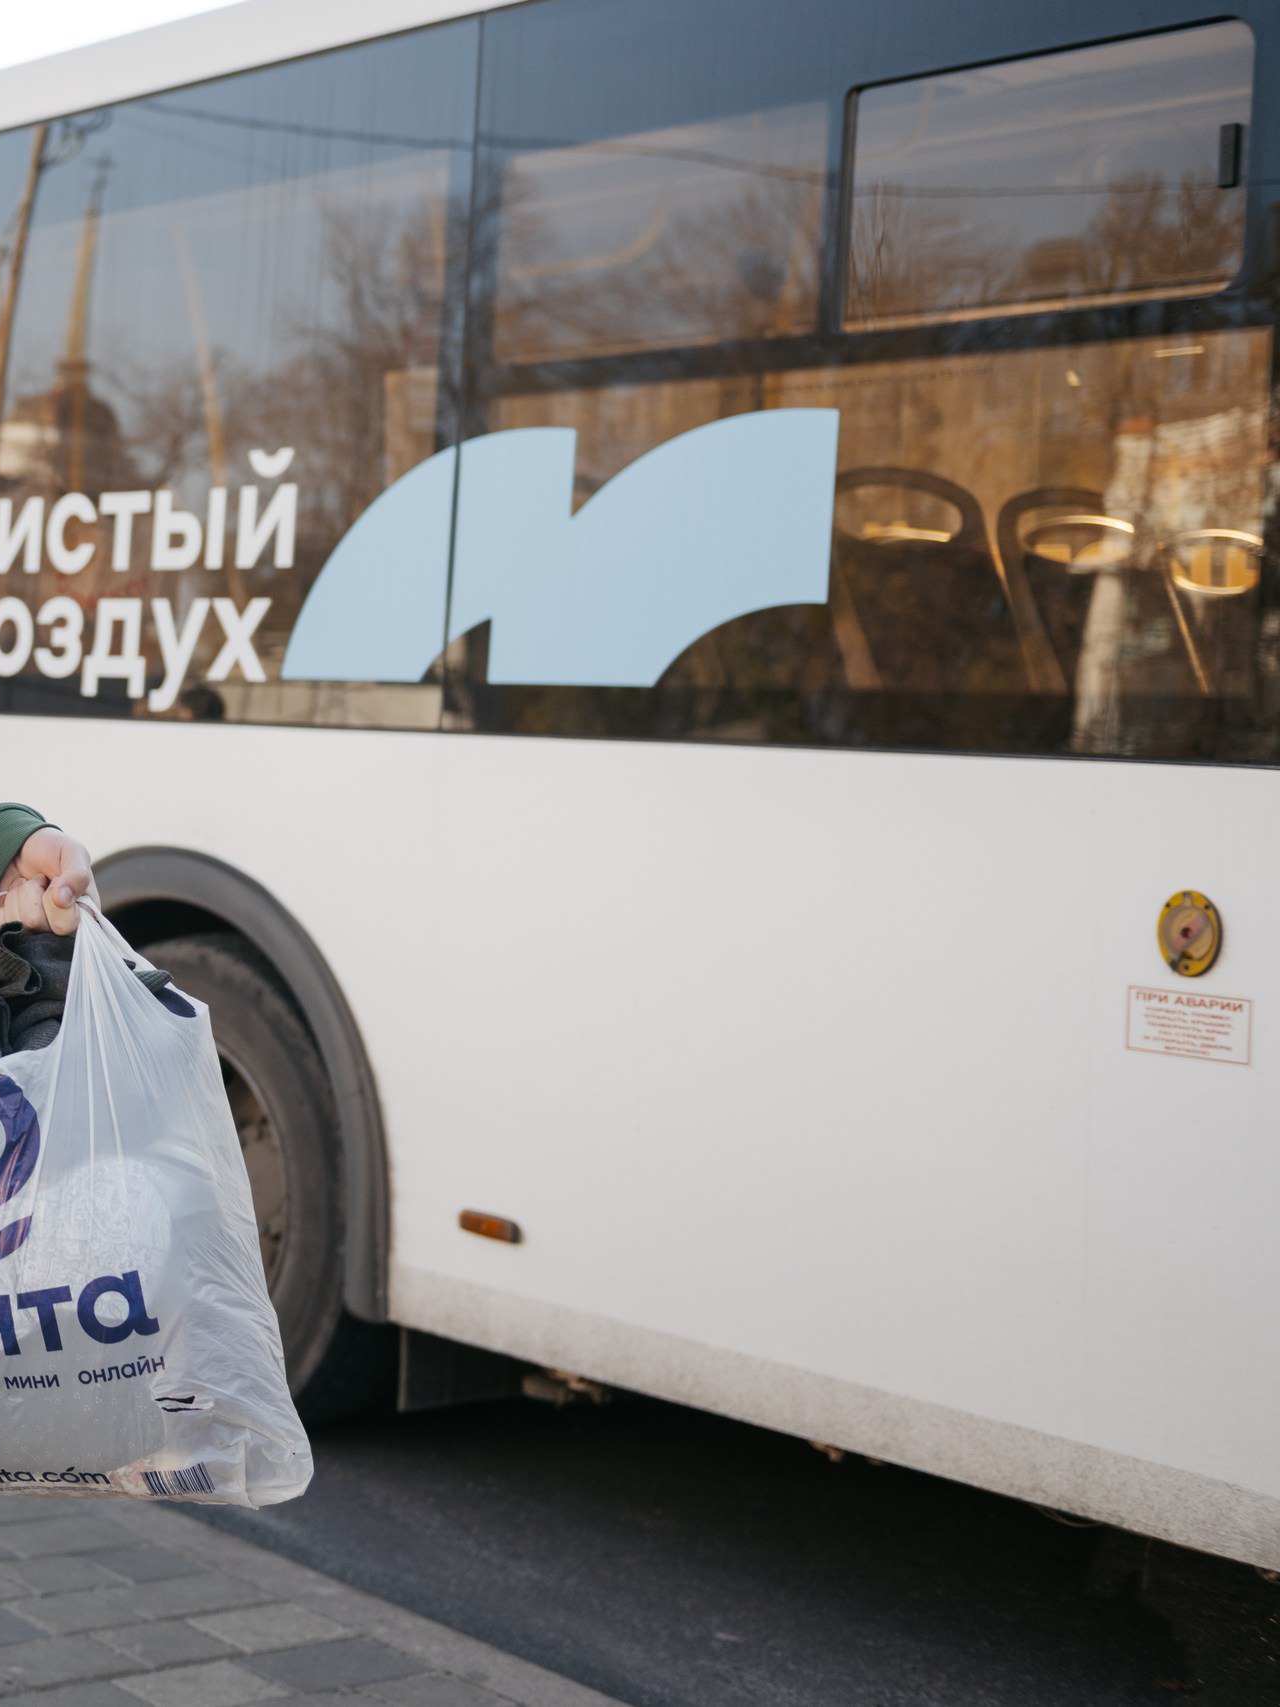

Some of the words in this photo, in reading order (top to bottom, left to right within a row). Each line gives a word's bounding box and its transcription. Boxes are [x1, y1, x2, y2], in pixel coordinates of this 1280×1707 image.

[1136, 991, 1168, 1003] ПРИ
[1175, 996, 1244, 1012] АВАРИИ
[4, 1374, 60, 1390] мини
[78, 1355, 166, 1386] онлайн
